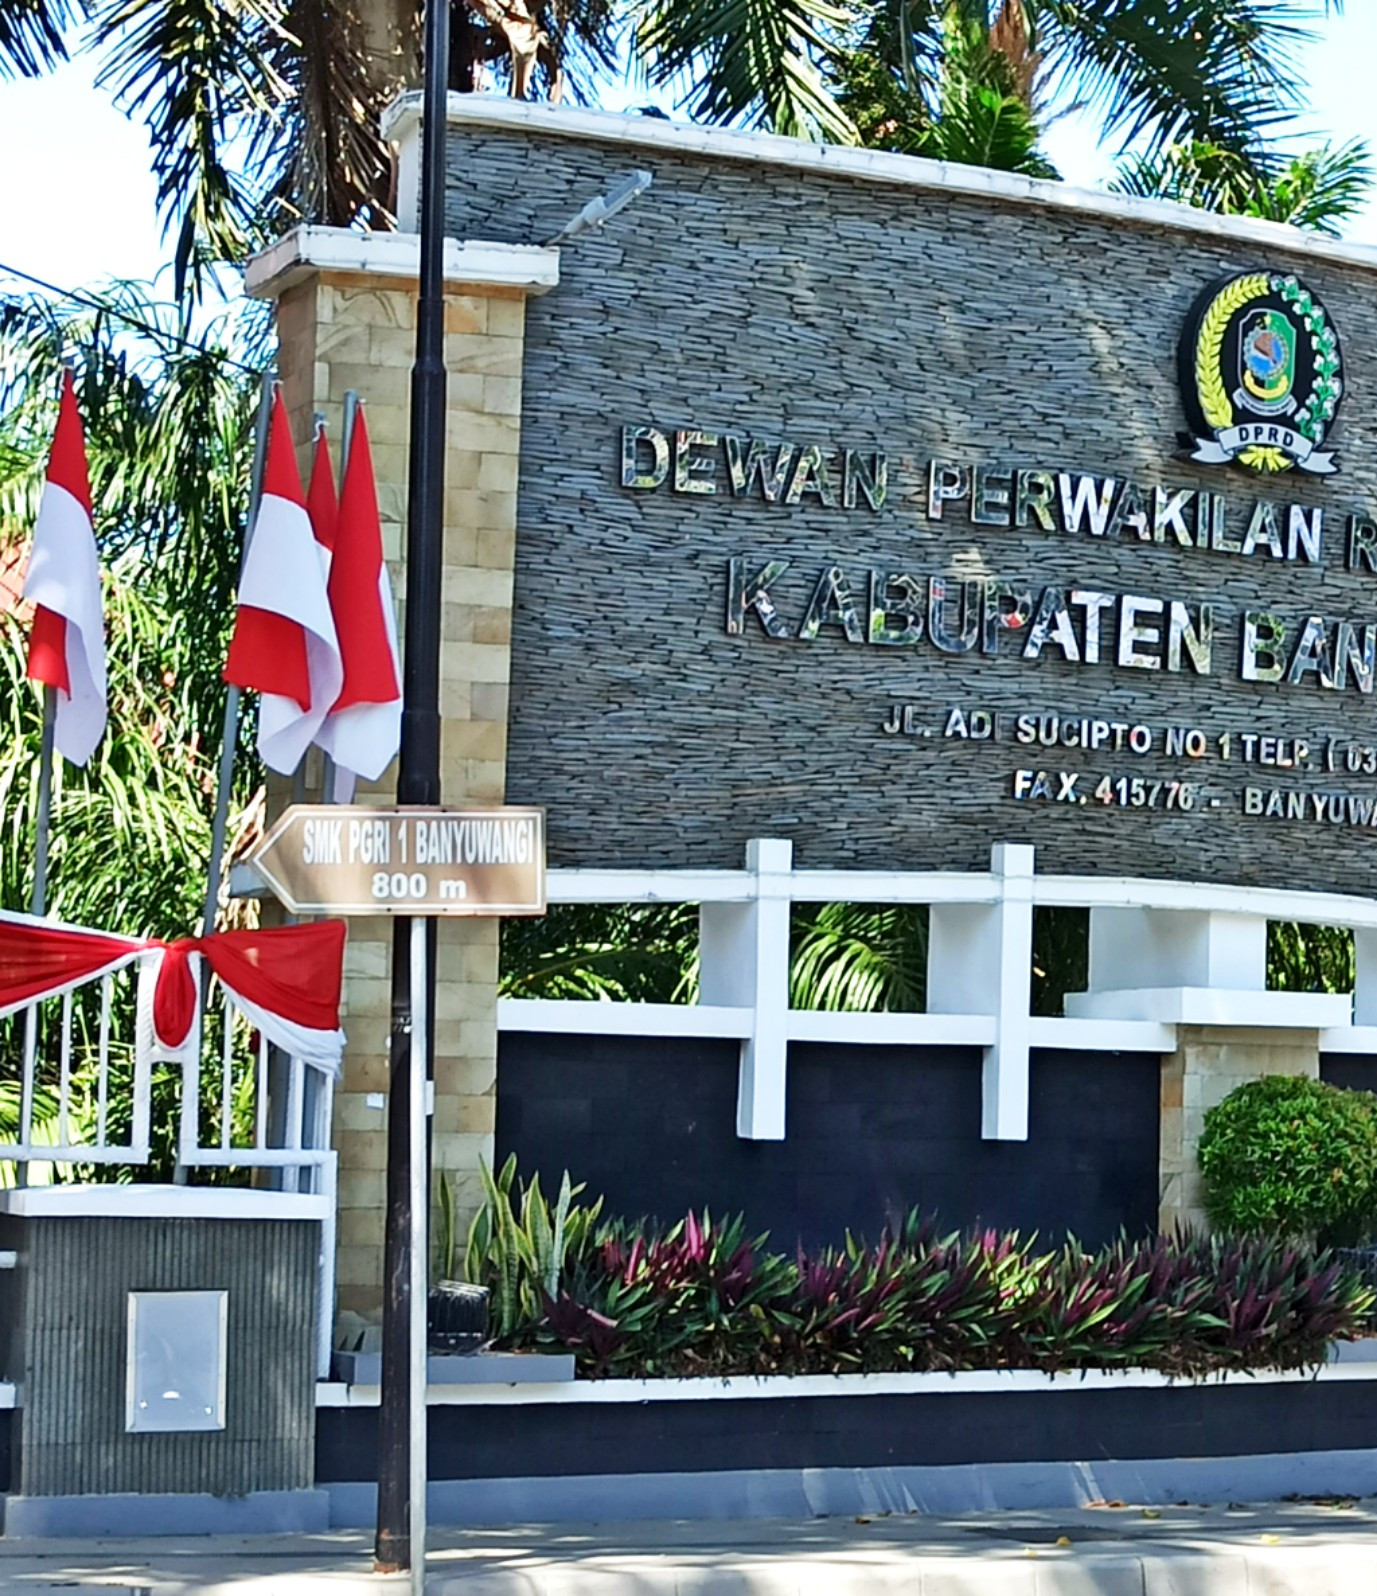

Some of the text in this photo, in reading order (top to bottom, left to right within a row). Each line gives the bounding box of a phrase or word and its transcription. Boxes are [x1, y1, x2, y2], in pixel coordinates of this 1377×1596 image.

[1239, 426, 1295, 448] DPRD
[621, 425, 887, 511] DEWAN
[927, 458, 1323, 562] PERWAKILAN
[726, 557, 1213, 675] KABUPATEN
[945, 708, 1000, 741] ADI
[1017, 713, 1151, 754] SUCIPTO
[1166, 728, 1206, 757] NO
[1219, 732, 1230, 760] 1
[1014, 769, 1088, 804] FAX.
[1095, 775, 1195, 811] 415776
[303, 820, 534, 864] SMK PGRI 1 BANYUWANGI
[371, 872, 467, 899] 800 m
